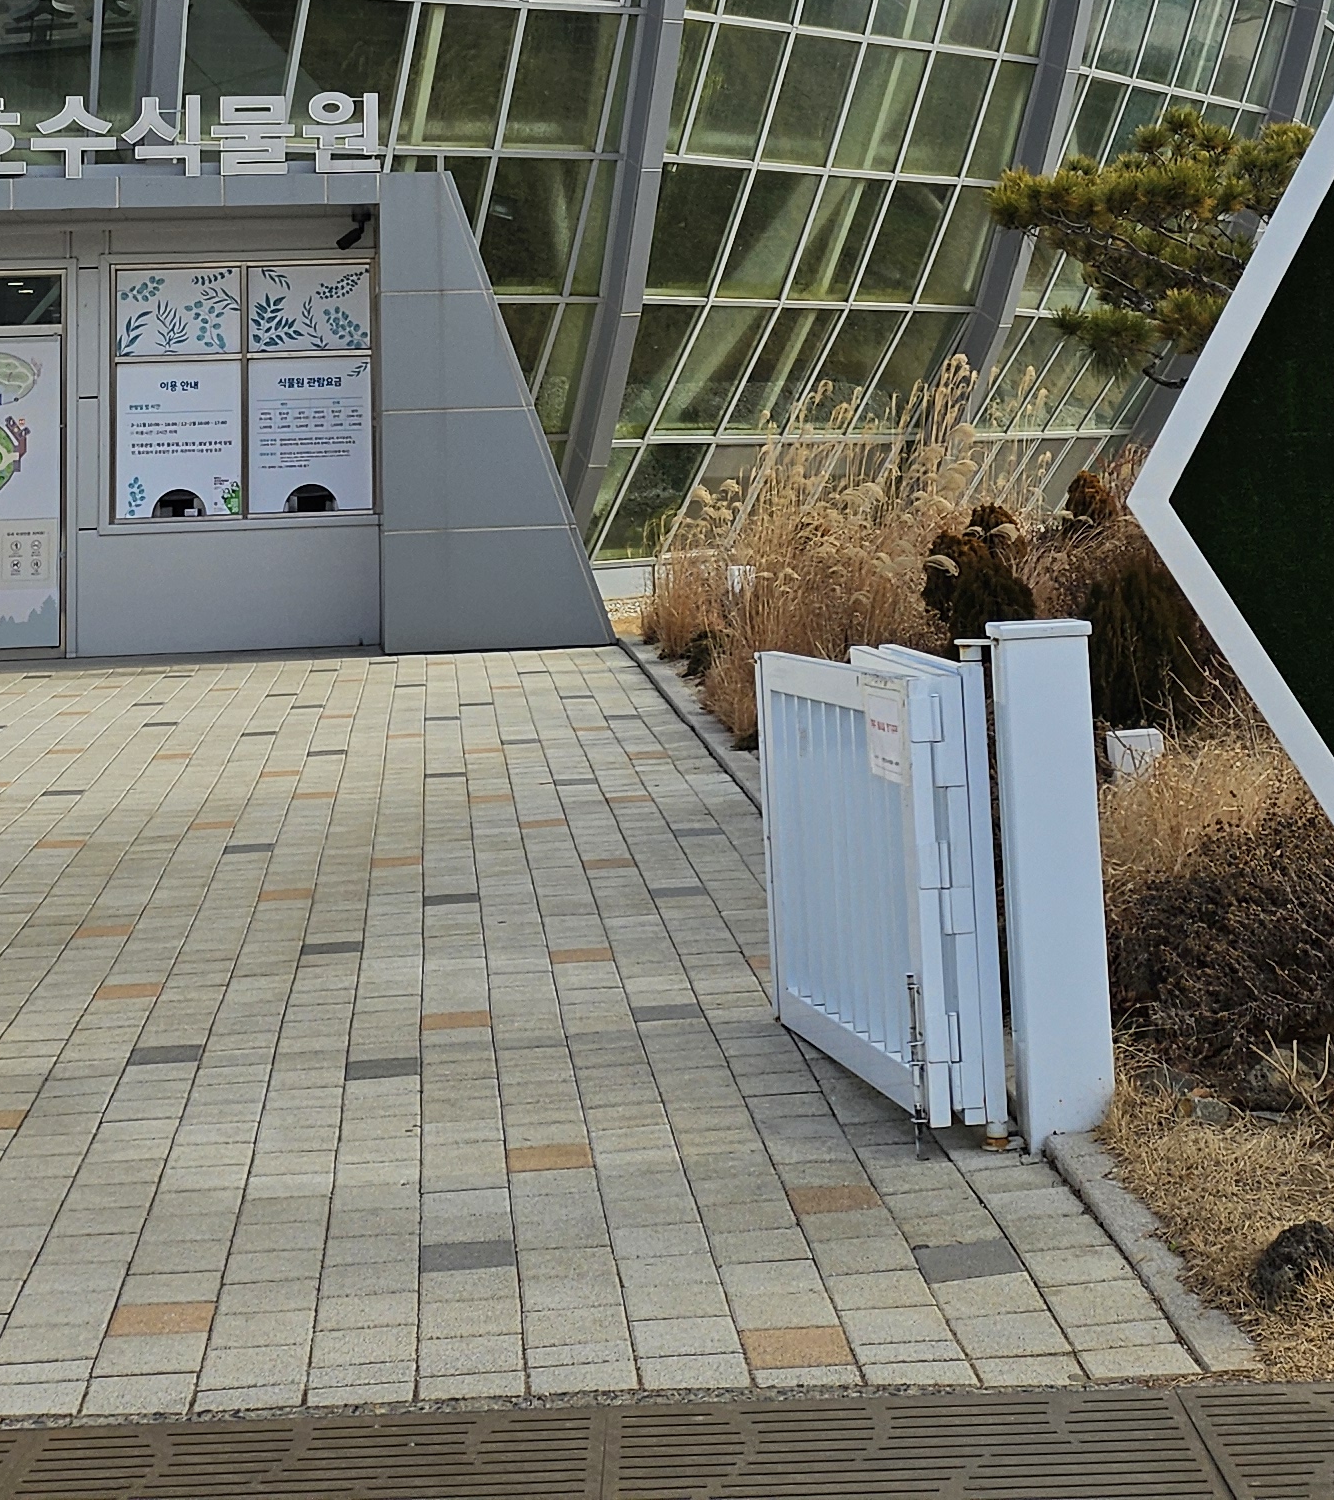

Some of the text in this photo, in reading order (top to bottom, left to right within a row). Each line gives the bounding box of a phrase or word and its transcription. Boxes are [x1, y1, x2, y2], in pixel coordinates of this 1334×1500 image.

[160, 381, 199, 392] 이용 안내
[278, 377, 342, 388] 식물원 관람요금
